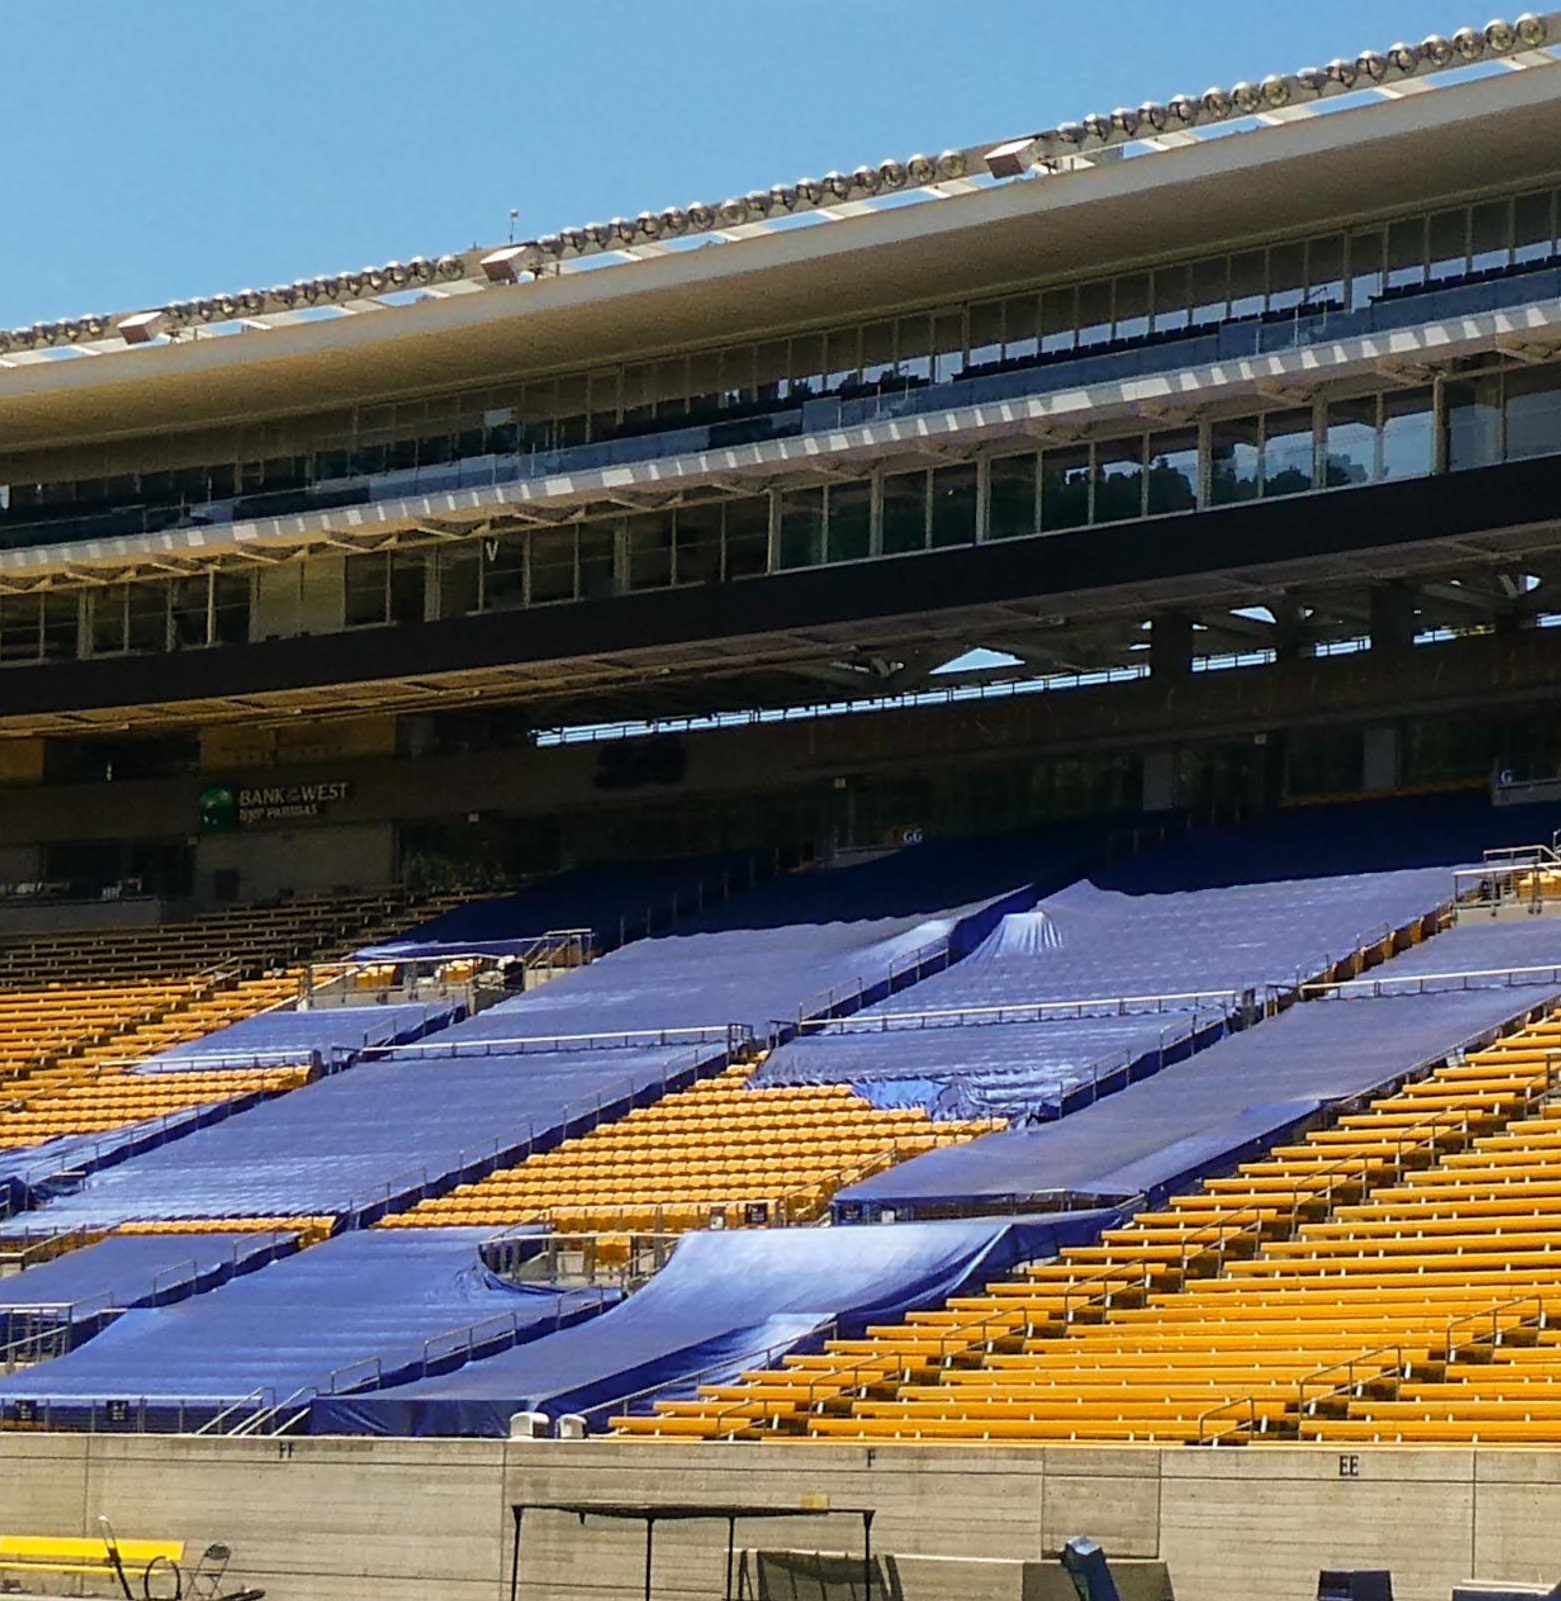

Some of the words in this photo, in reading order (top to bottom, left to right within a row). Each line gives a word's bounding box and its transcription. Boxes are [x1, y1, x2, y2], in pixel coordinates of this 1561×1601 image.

[239, 787, 286, 807] BANK
[300, 782, 350, 802] WEST
[867, 1449, 876, 1468] F
[1339, 1455, 1359, 1476] EE
